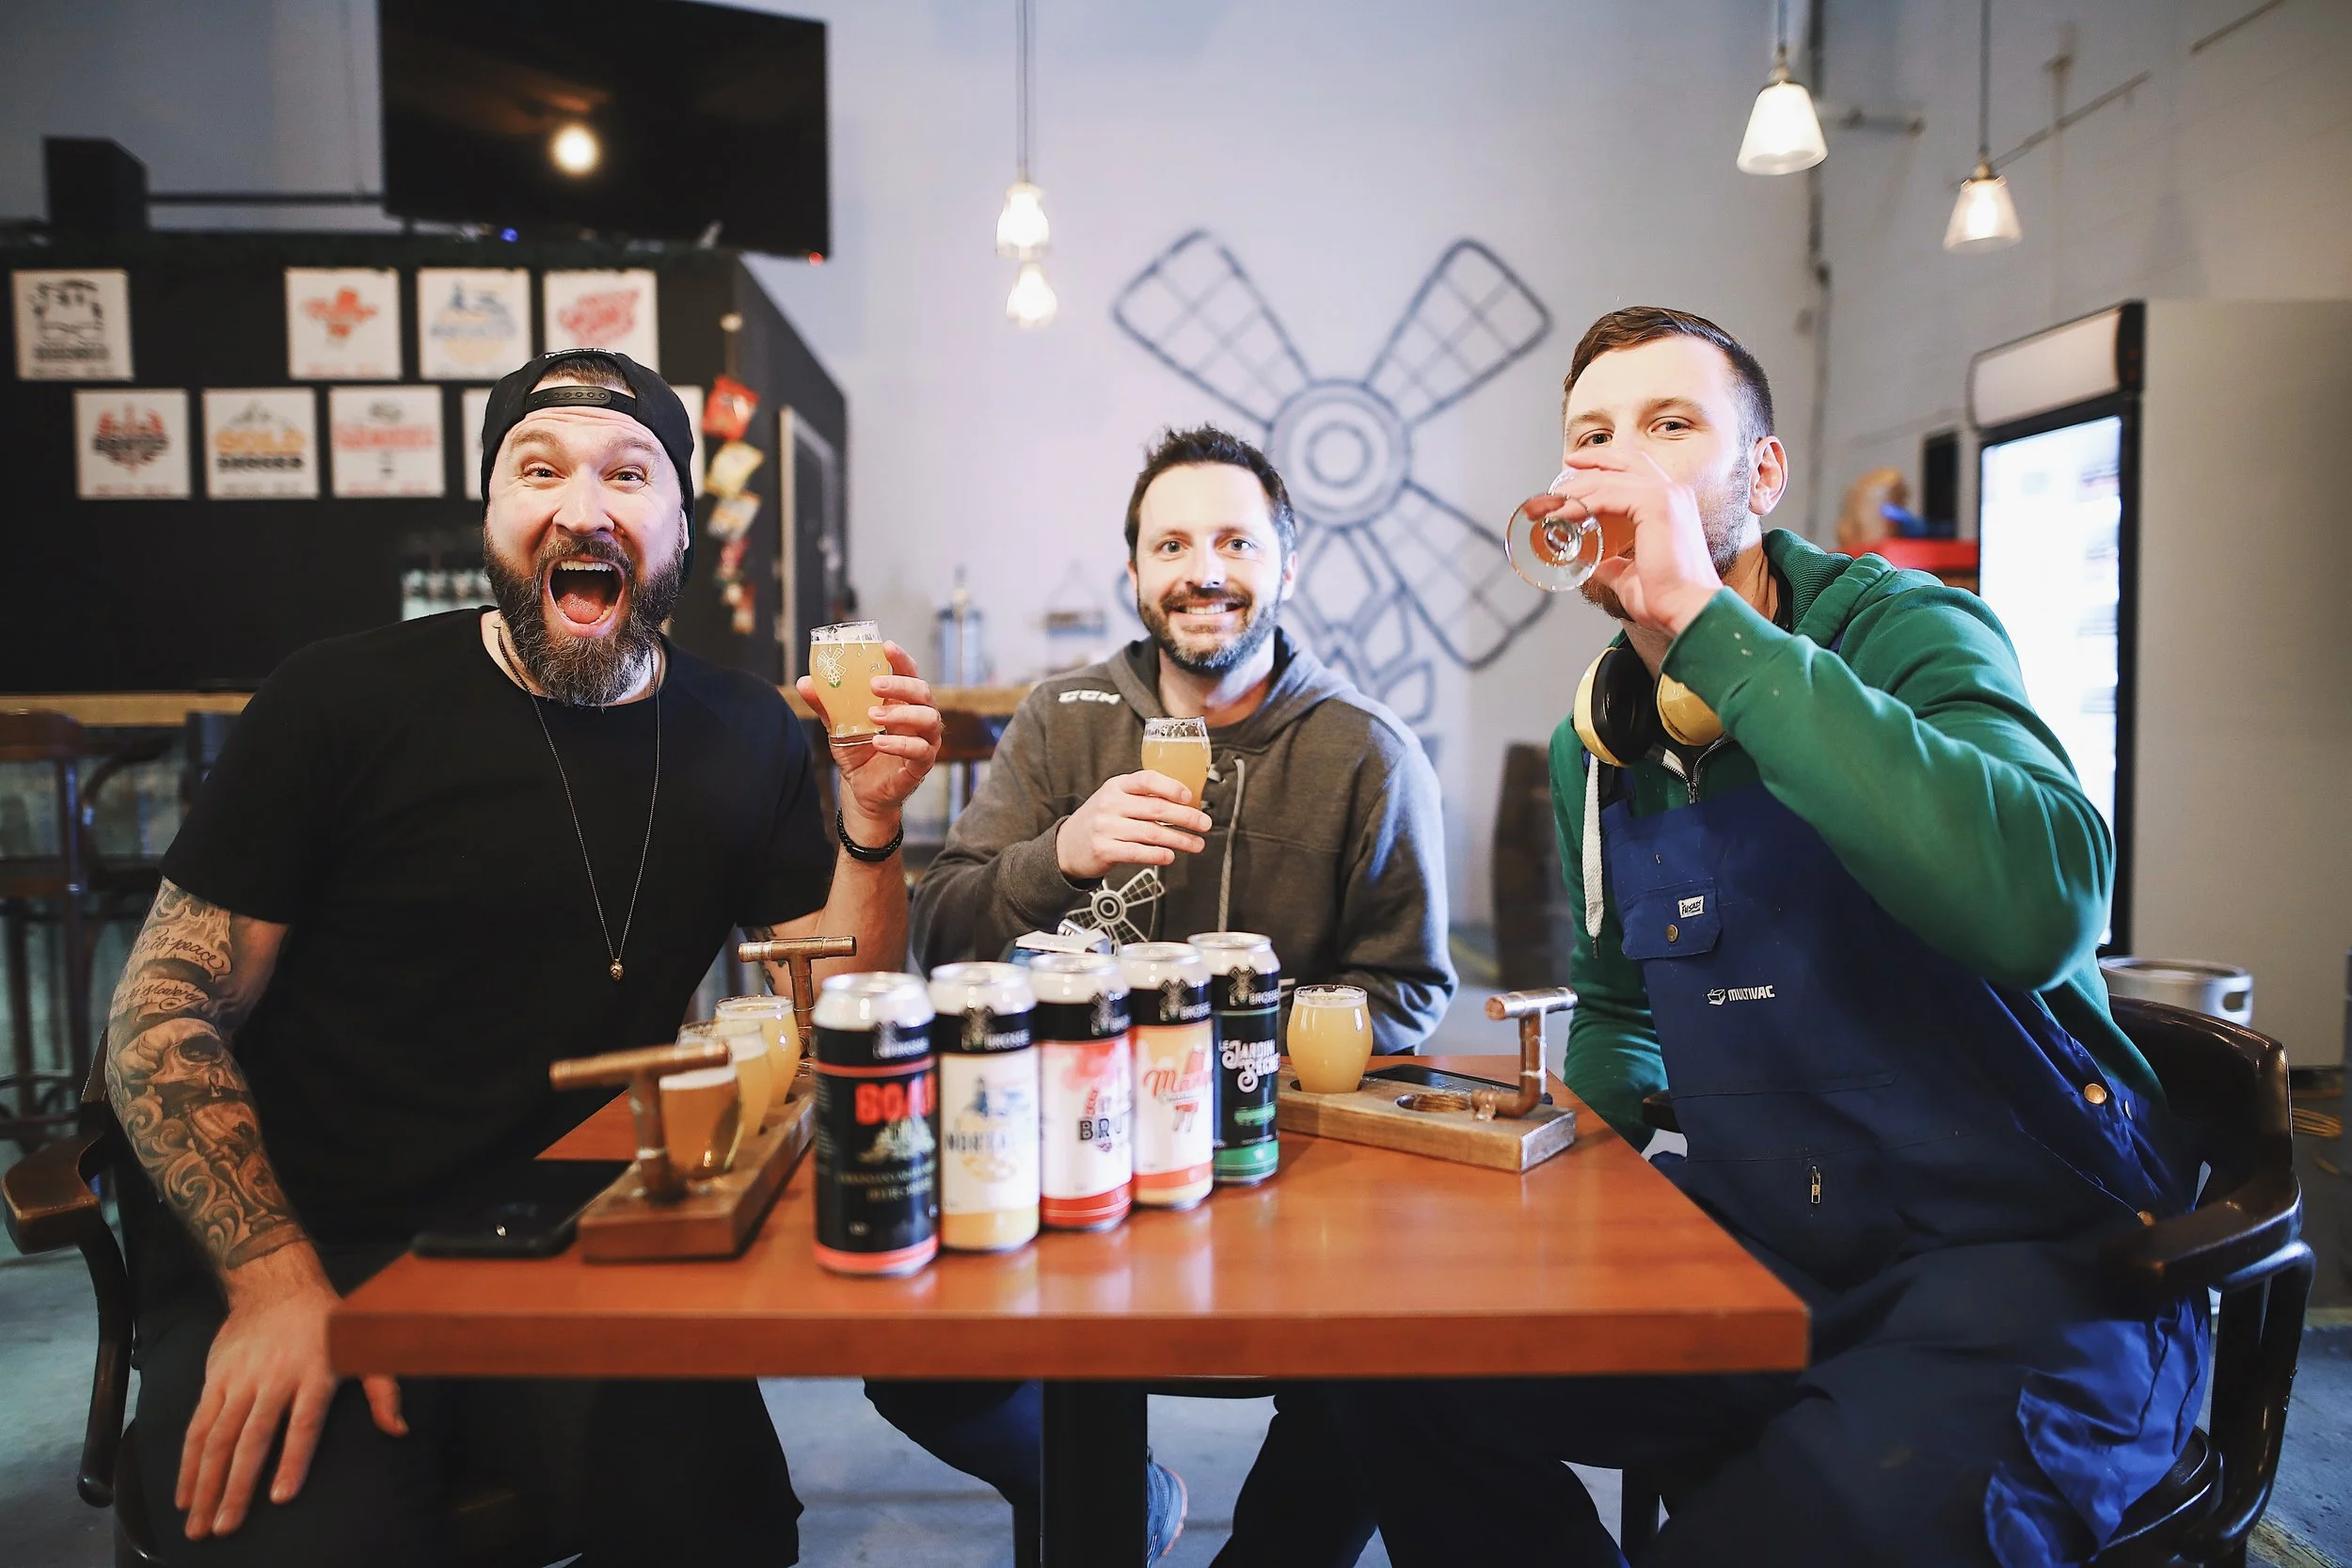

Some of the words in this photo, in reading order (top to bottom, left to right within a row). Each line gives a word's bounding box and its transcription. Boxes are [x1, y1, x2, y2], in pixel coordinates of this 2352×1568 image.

[164, 937, 225, 970] peace
[143, 981, 206, 1009] slavery
[1728, 985, 1775, 1002] MULTIVAC
